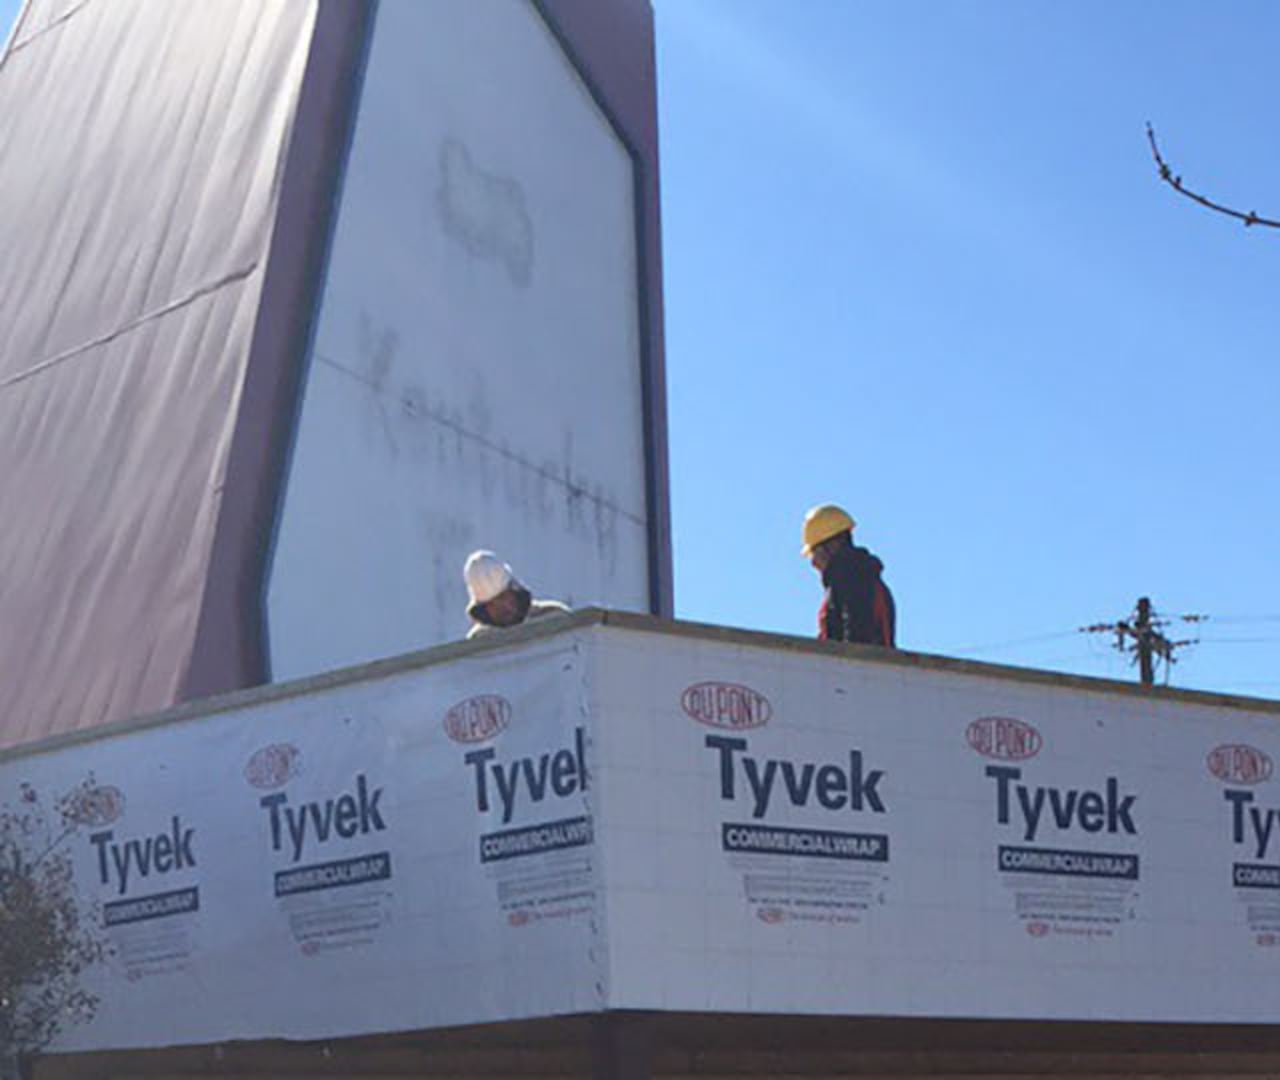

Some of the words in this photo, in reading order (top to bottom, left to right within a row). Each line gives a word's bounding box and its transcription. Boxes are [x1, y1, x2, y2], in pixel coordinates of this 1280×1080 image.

[704, 734, 887, 819] Tyvek
[985, 765, 1138, 842] Tyvek
[90, 815, 197, 895] Tyvek
[260, 774, 387, 862] Tyvek
